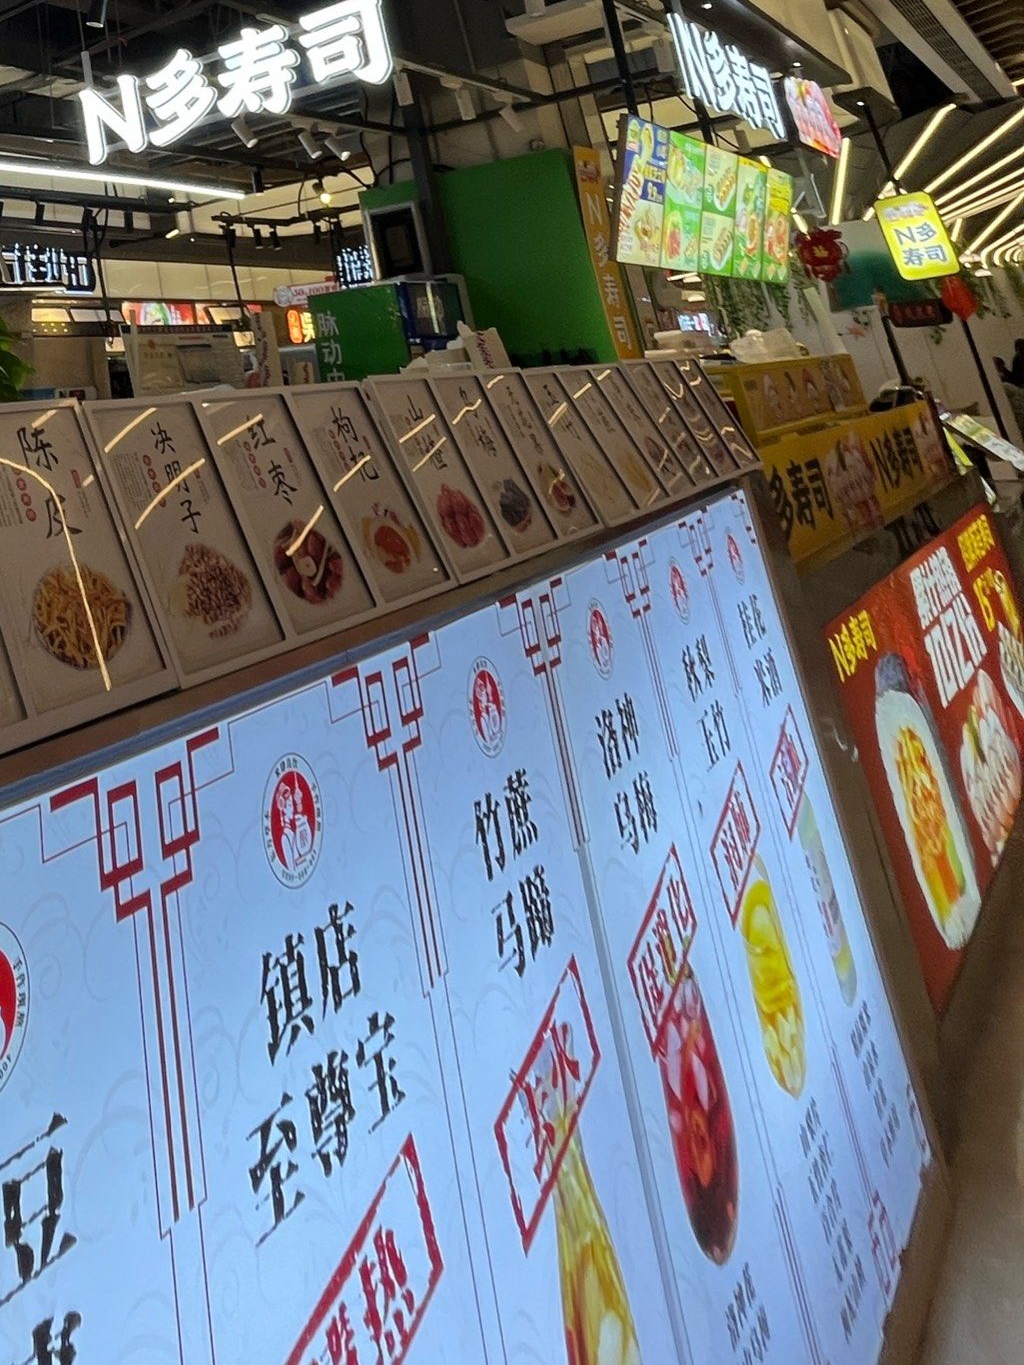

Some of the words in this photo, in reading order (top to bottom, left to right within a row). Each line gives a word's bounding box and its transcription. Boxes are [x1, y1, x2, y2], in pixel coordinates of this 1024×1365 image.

[666, 13, 788, 139] N多寿司
[586, 190, 633, 352] N多寿司
[894, 222, 937, 246] N多
[903, 244, 948, 267] 寿司
[16, 425, 83, 539] 陈皮
[150, 421, 202, 534] 决明子
[828, 609, 878, 683] N多寿司
[594, 691, 640, 781] 洛神
[246, 1011, 406, 1249] 至尊宝
